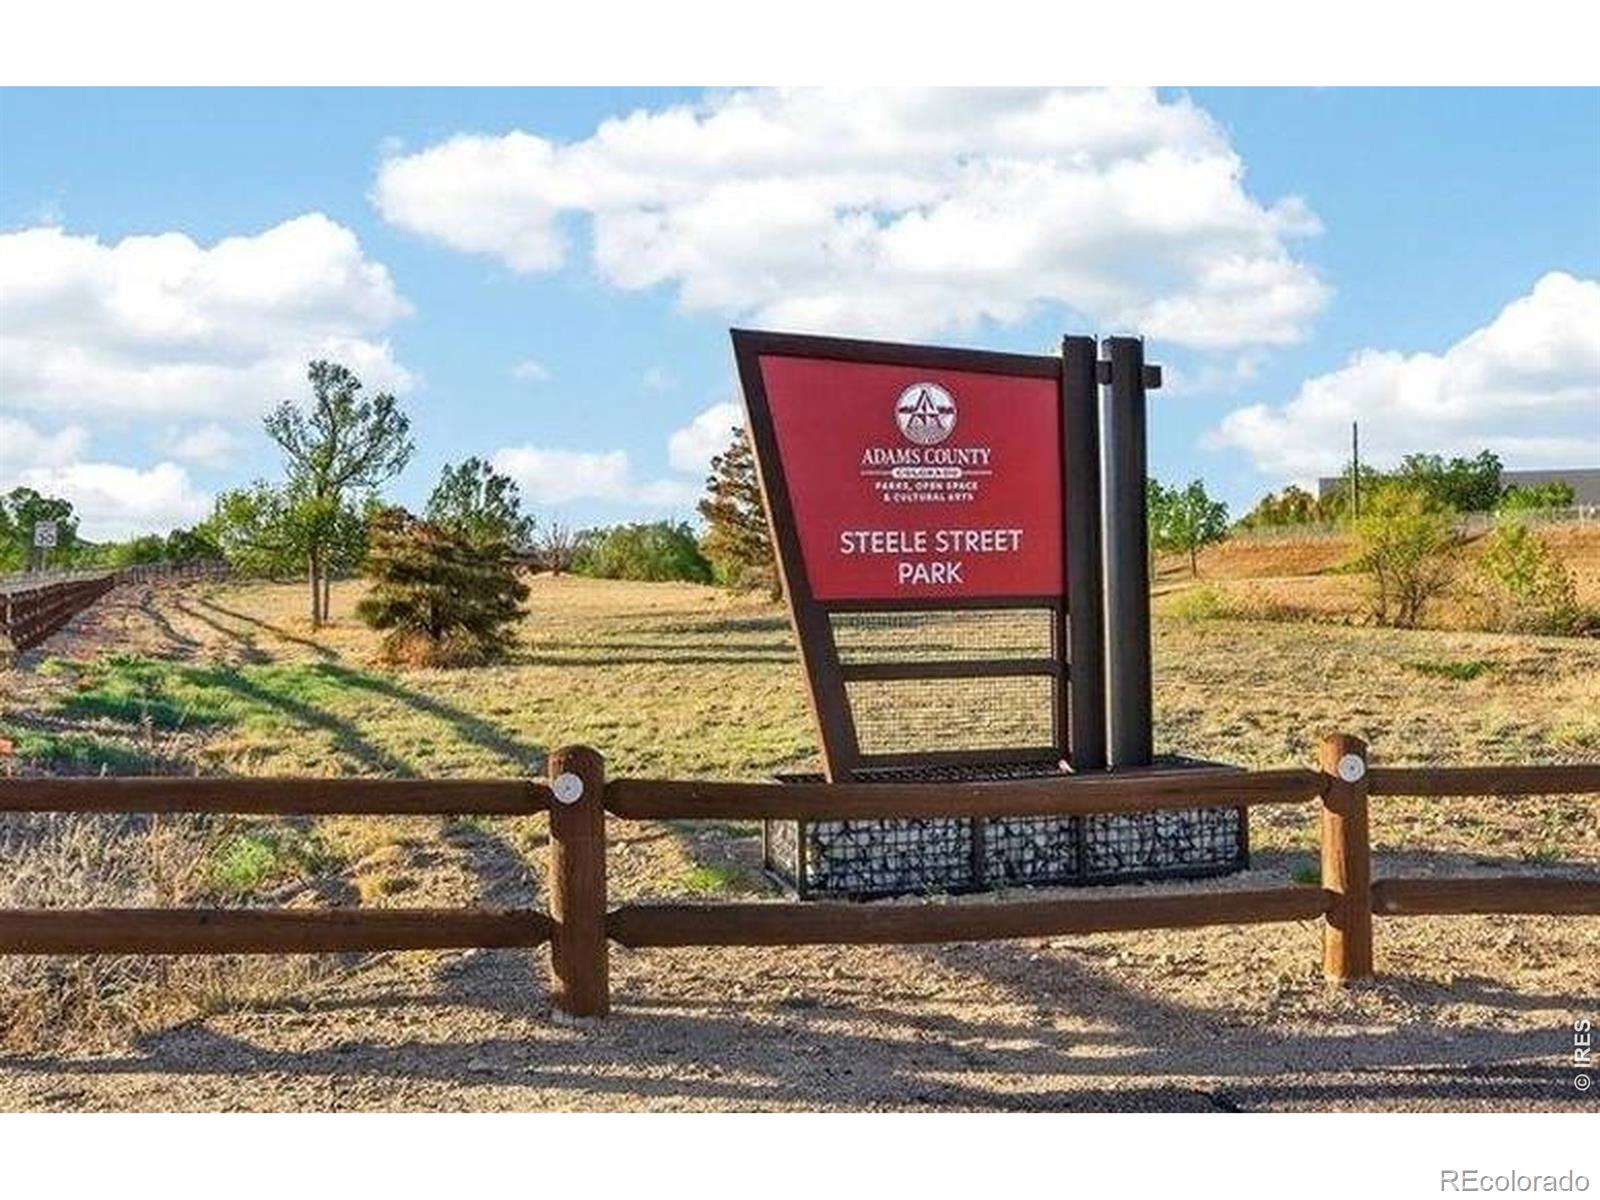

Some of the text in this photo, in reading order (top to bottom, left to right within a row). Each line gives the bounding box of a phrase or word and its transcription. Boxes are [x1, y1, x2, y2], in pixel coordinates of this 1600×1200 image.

[861, 448, 991, 465] ADAMS COUNTY
[915, 481, 943, 491] OPEN
[946, 481, 978, 491] SPACE
[894, 492, 946, 502] CULTURAL
[948, 492, 974, 501] ARTS
[840, 529, 1024, 554] STEELE STREET
[899, 562, 964, 585] PARK
